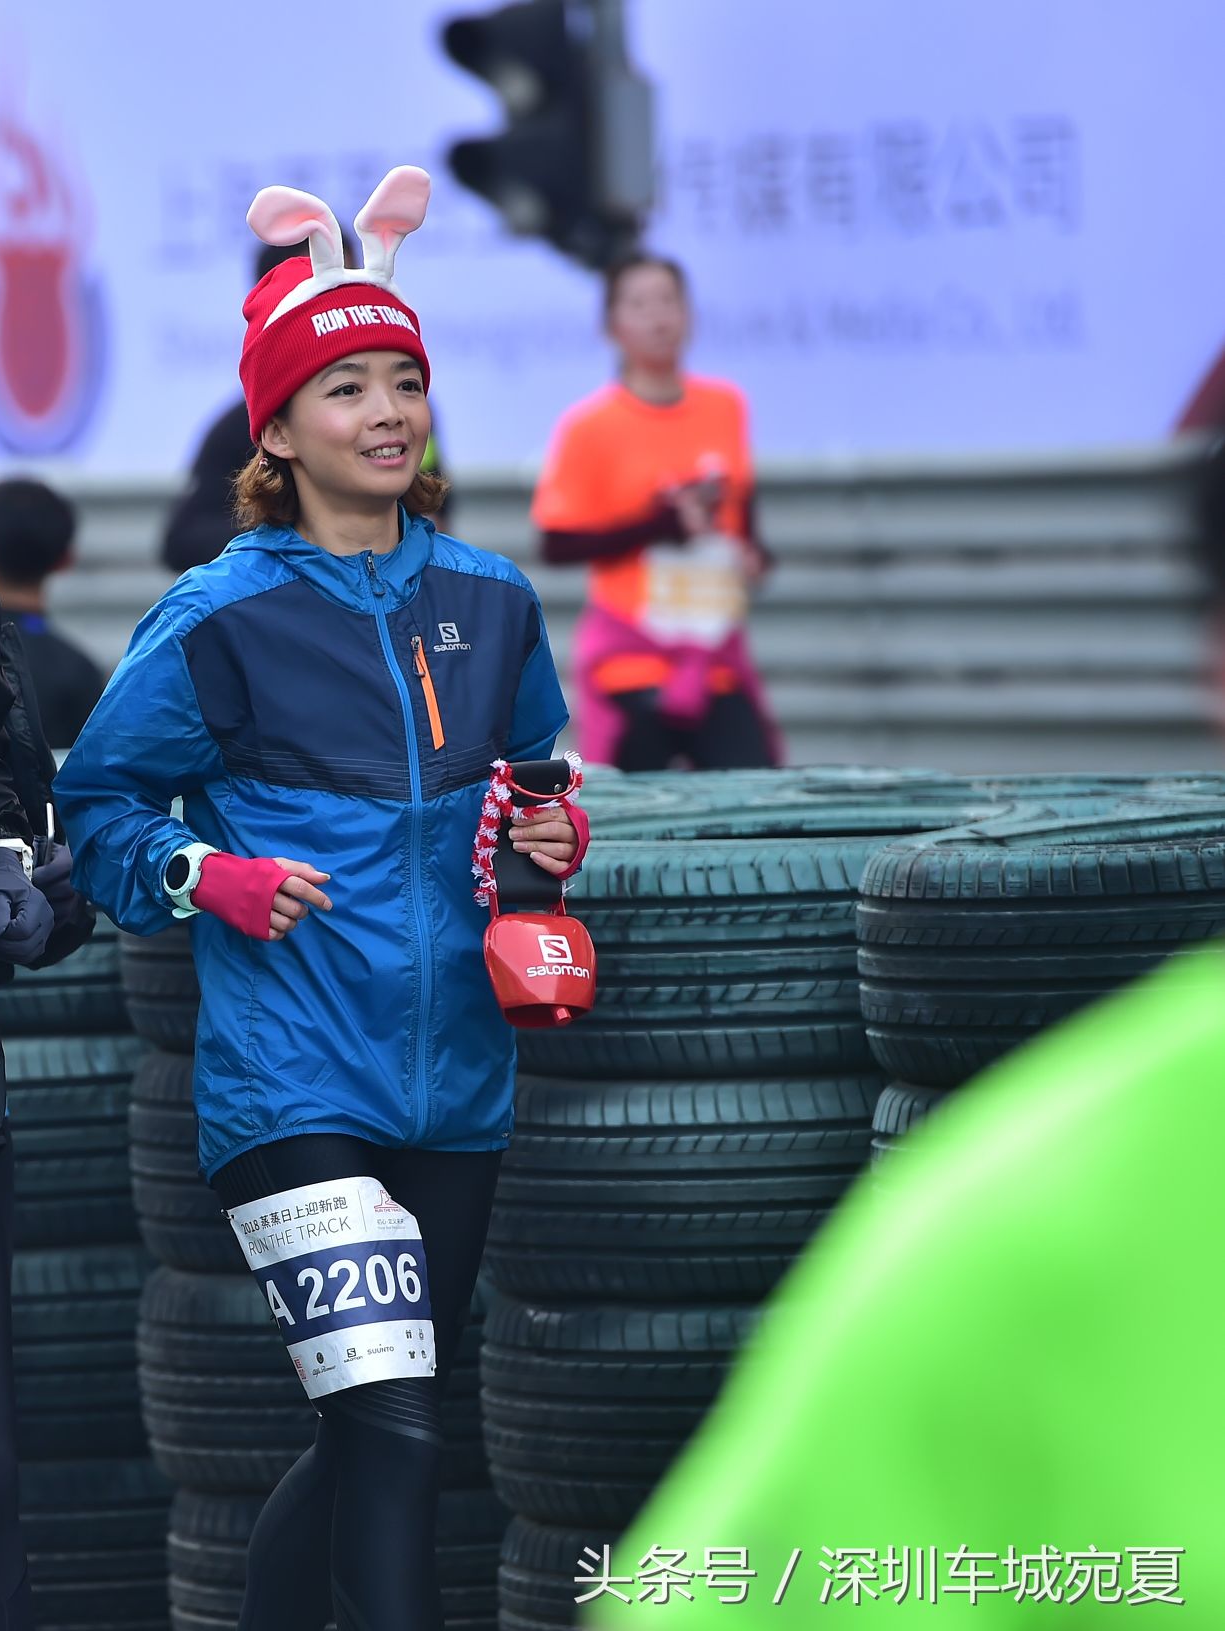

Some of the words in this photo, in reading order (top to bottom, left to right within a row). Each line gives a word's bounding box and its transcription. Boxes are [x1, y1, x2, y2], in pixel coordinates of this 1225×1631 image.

[311, 308, 350, 338] RUN
[344, 304, 381, 327] THE
[241, 1219, 260, 1235] 2018
[259, 1196, 348, 1230] 蒸蒸日上迎新跑
[248, 1236, 269, 1256] RUN
[268, 1228, 294, 1248] THE
[296, 1216, 352, 1241] TRACK
[265, 1279, 296, 1326] A
[297, 1252, 422, 1320] 2206
[366, 1346, 395, 1355] SUUNTO
